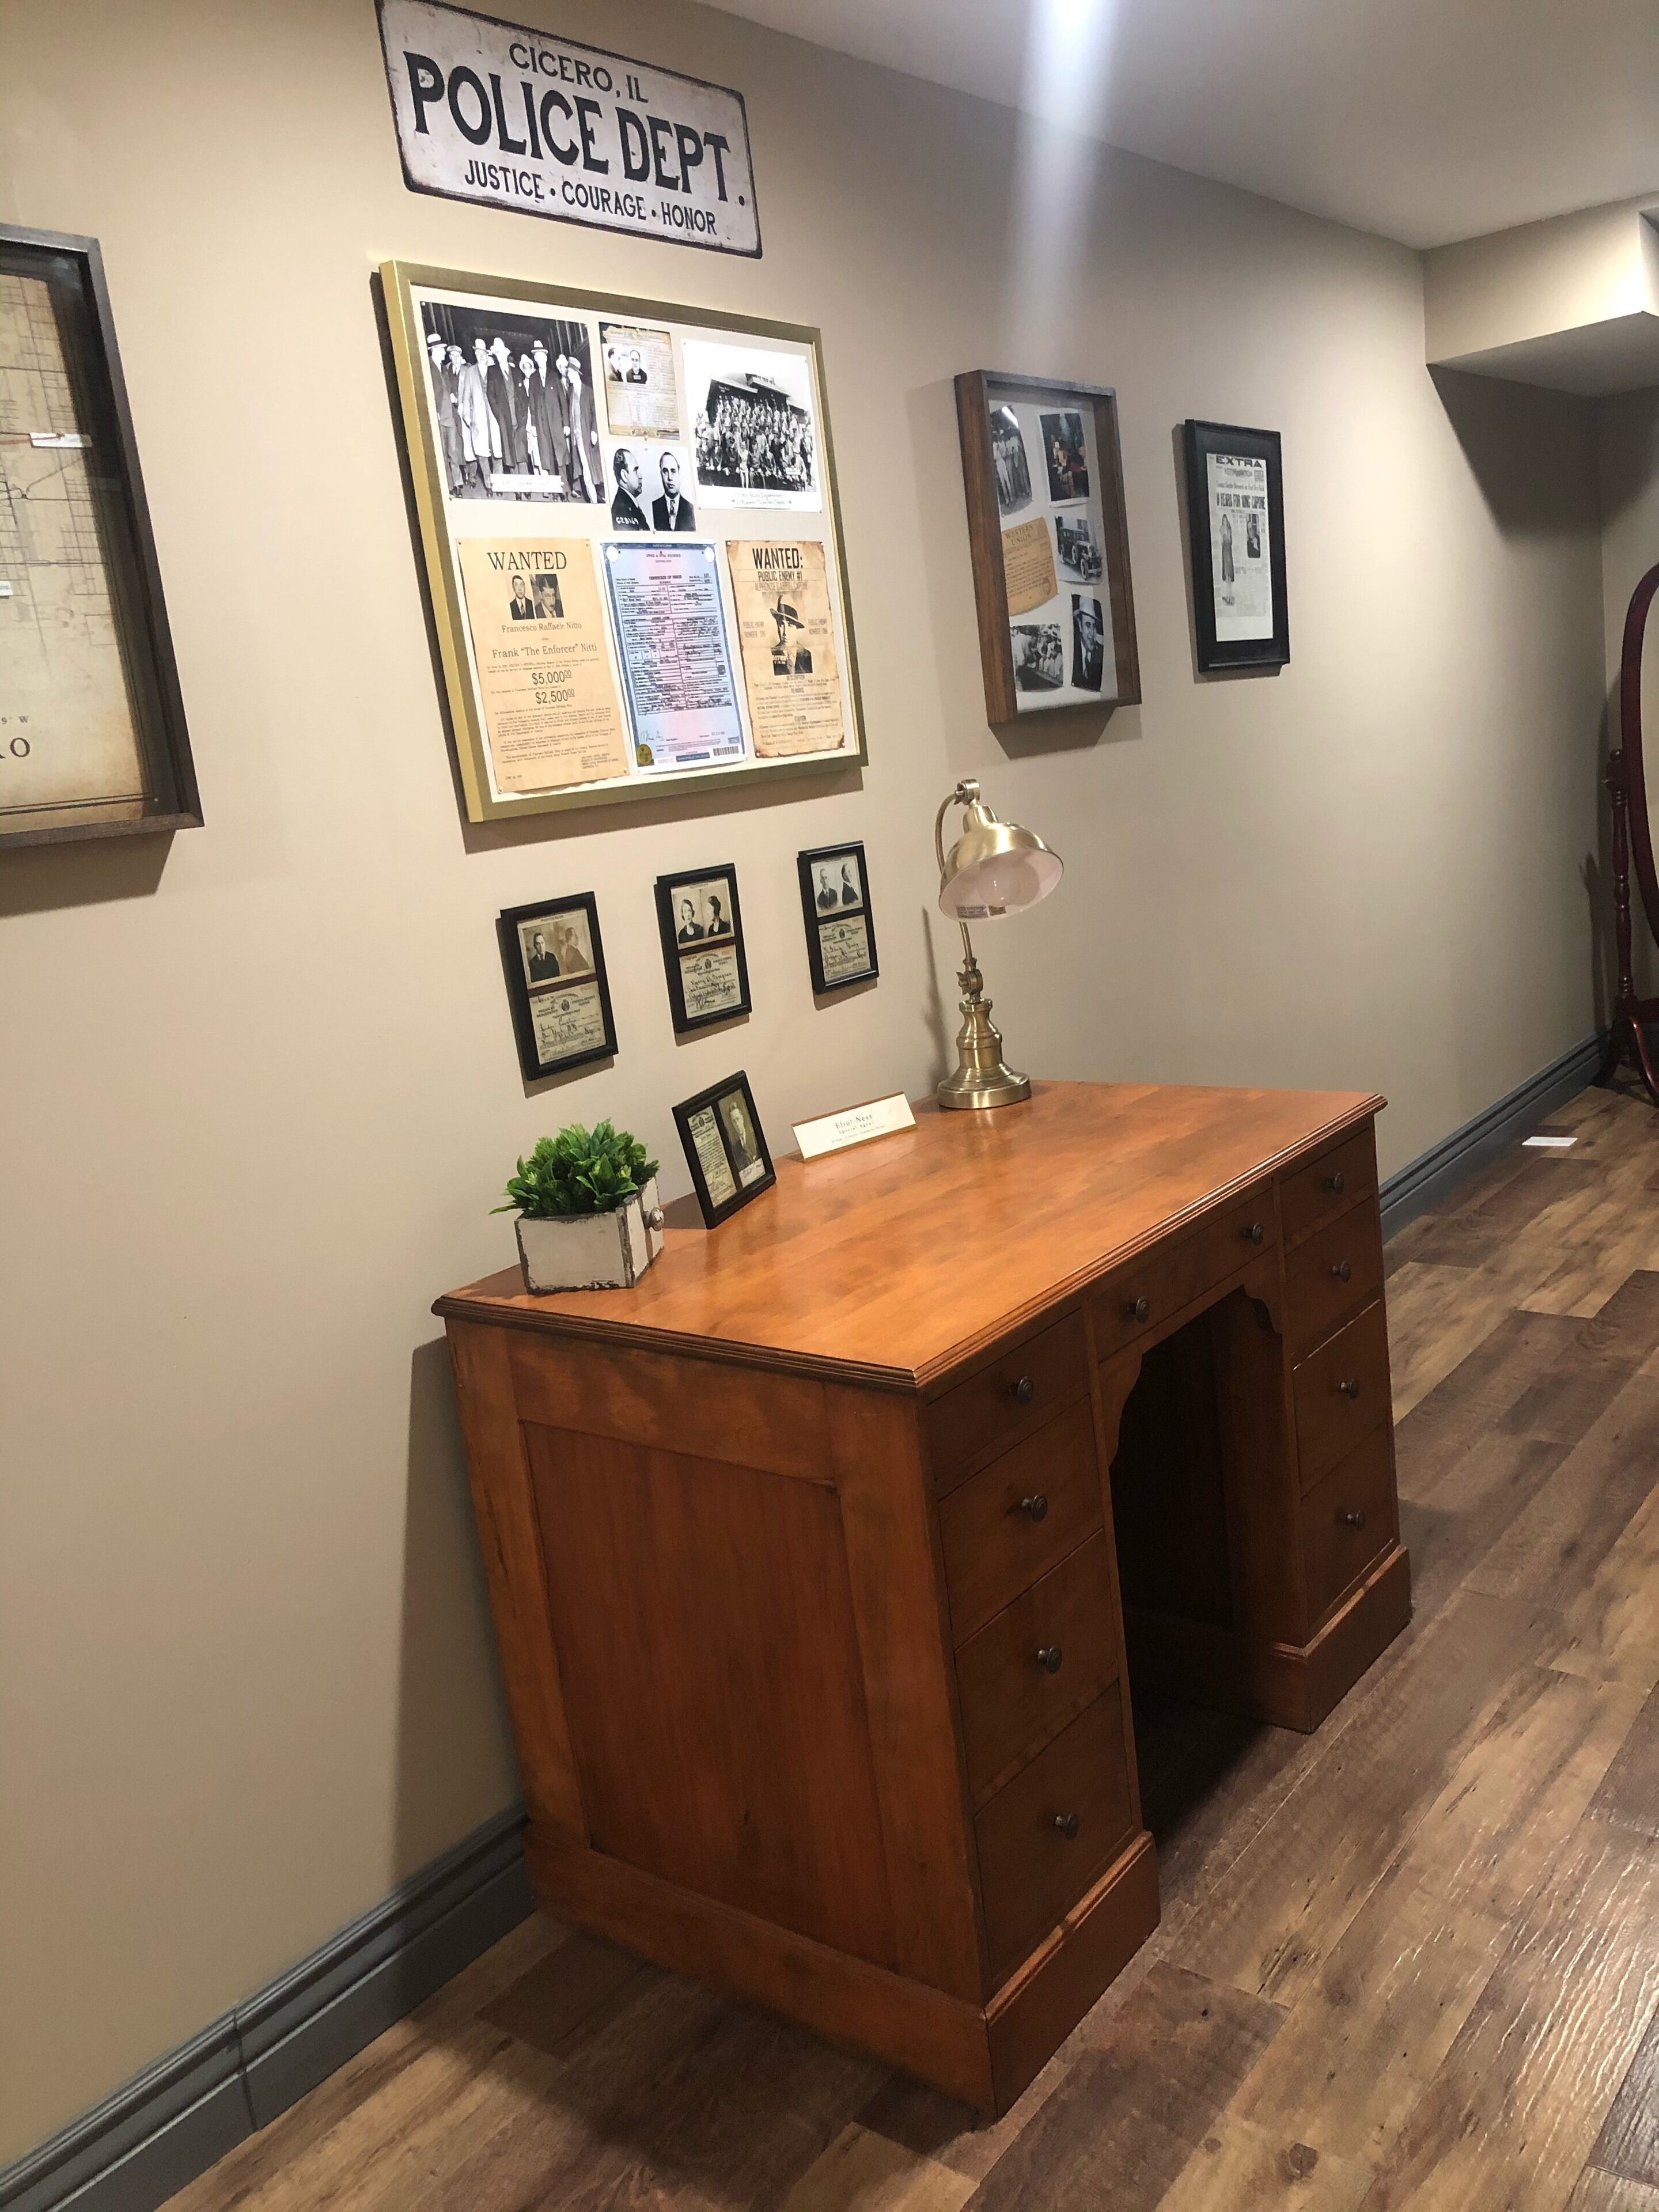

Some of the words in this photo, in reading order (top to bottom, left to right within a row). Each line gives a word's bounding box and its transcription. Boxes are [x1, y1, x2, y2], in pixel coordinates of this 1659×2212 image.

[509, 43, 620, 99] CICERO,
[626, 75, 649, 103] IL
[403, 51, 609, 175] POLICE
[615, 107, 745, 206] DEPT.
[464, 160, 544, 199] JUSTICE
[562, 180, 646, 220] COURAGE
[662, 202, 717, 236] HONOR
[1215, 455, 1262, 468] EXTRA
[1005, 524, 1033, 539] WESTERN
[1011, 533, 1032, 546] UNION
[487, 551, 567, 571] WANTED
[752, 548, 803, 569] WANTED:
[757, 571, 777, 581] PUBLIC
[779, 571, 795, 581] ENEMY
[502, 624, 537, 633] Francesco
[539, 622, 565, 631] Raffaele
[566, 622, 582, 630] Nitto
[492, 647, 519, 658] Frank
[581, 642, 597, 652] Nitti
[835, 1120, 853, 1129] Eliot
